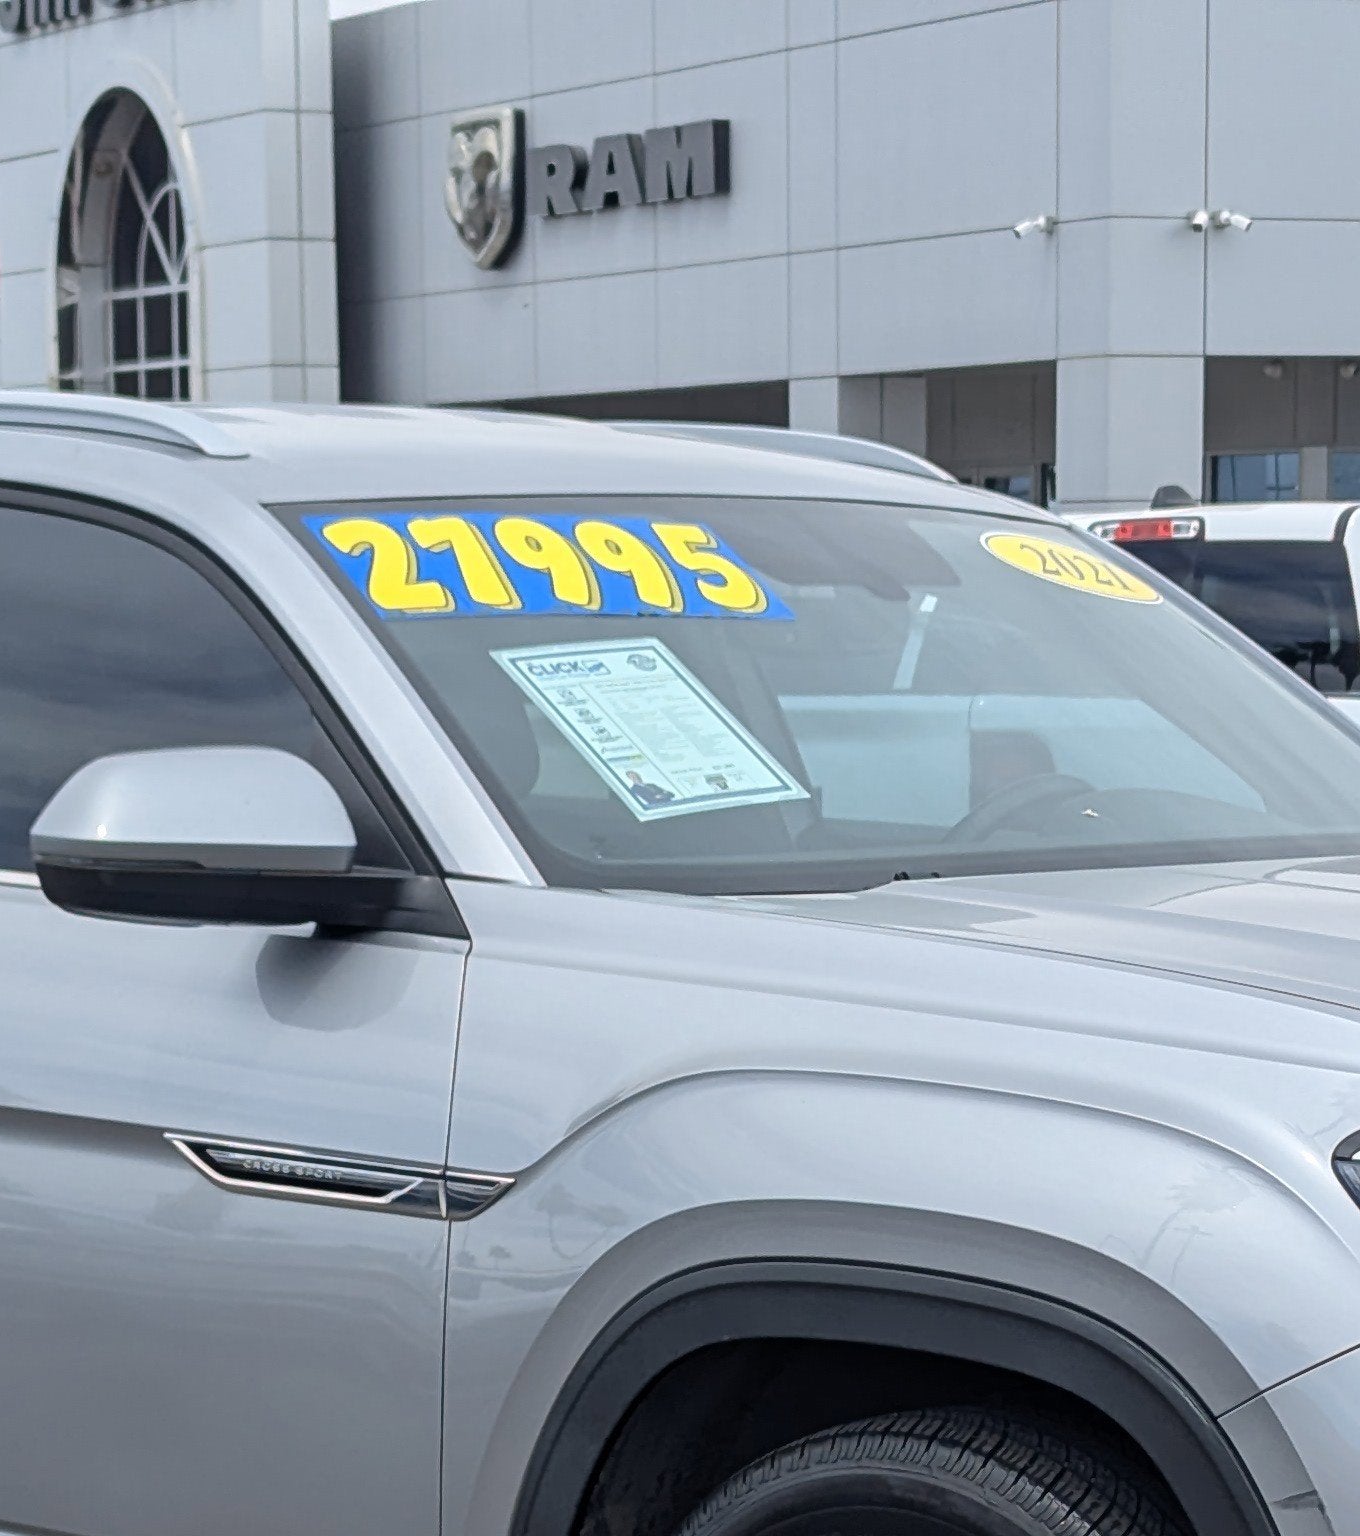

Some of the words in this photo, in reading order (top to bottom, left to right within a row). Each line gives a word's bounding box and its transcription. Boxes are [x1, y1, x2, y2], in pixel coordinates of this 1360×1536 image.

[526, 118, 730, 216] RAM
[322, 516, 768, 613] 27995
[1019, 543, 1139, 593] 2021
[242, 1160, 291, 1173] CROSS
[295, 1166, 342, 1179] SPORT
